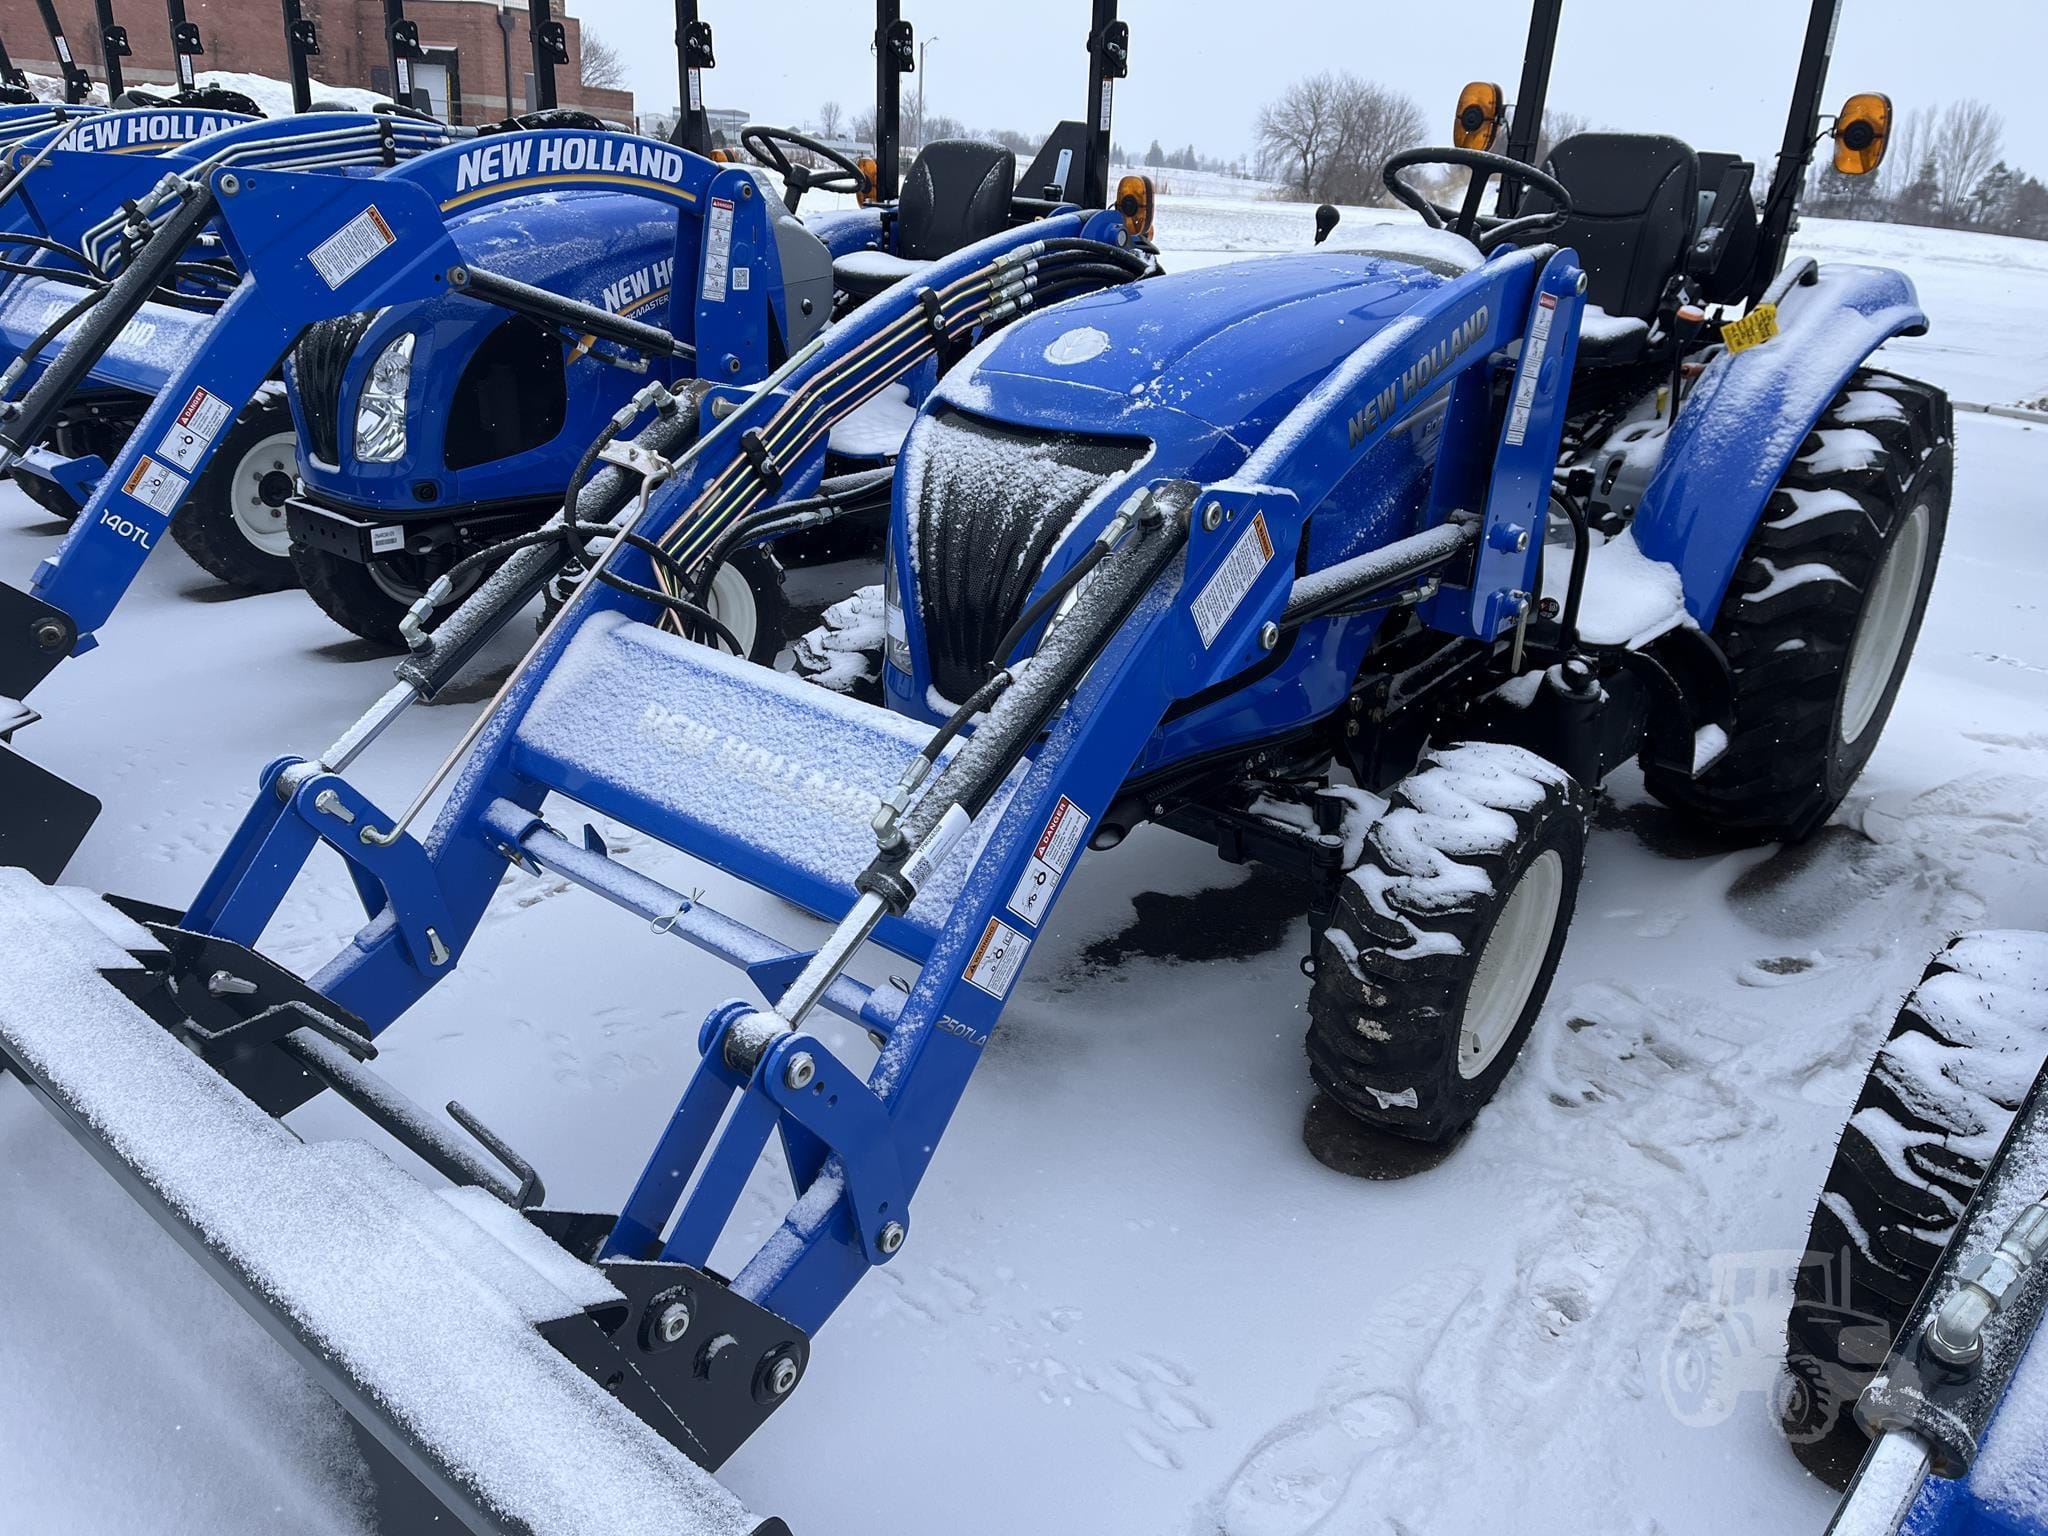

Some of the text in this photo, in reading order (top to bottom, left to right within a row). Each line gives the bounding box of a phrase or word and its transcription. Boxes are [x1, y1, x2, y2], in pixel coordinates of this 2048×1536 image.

[456, 137, 684, 192] NEW HOLLAND
[602, 267, 650, 315] NEW
[1347, 381, 1397, 450] NEW
[1401, 304, 1489, 403] HOLLAND
[187, 391, 205, 417] DANGER
[99, 508, 151, 551] 140TL
[1043, 802, 1067, 844] DANGER
[972, 925, 996, 965] WARNING
[935, 1014, 988, 1047] 250TLA
